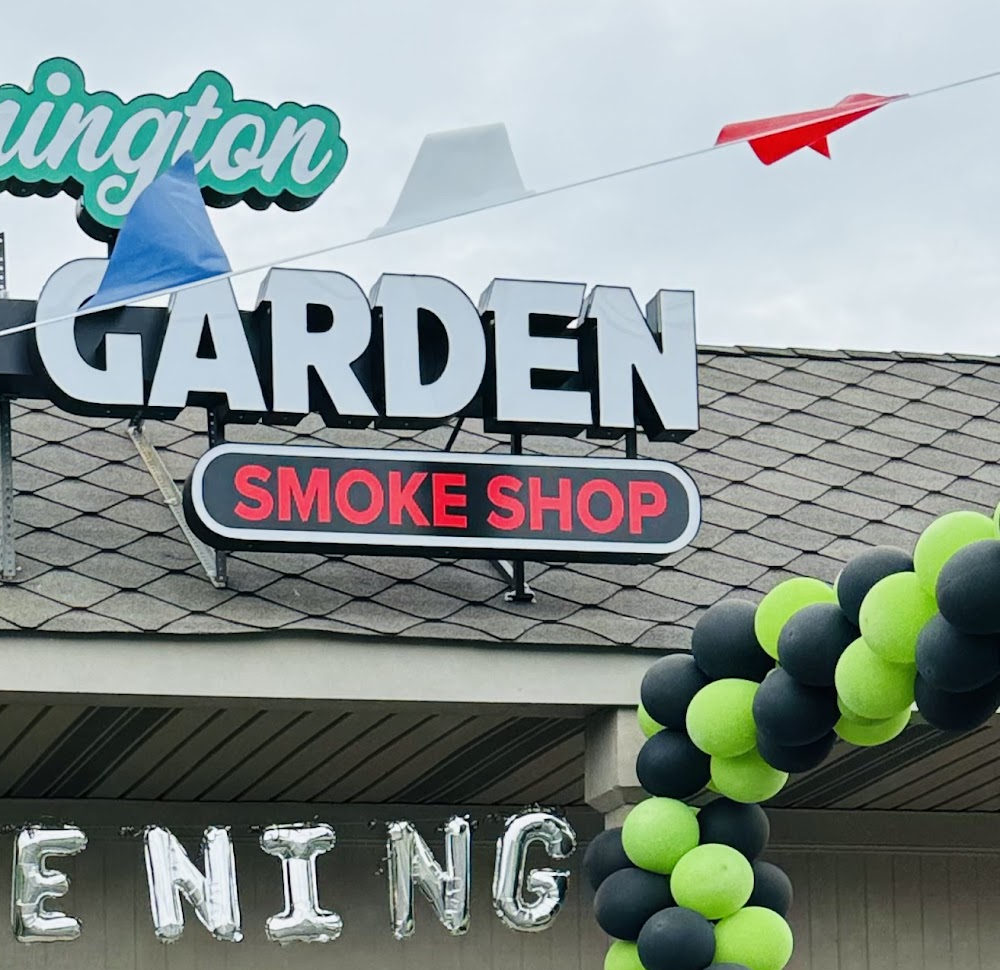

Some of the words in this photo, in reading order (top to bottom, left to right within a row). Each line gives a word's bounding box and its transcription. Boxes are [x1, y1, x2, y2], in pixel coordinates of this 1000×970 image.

[35, 258, 698, 434] GARDEN
[234, 464, 468, 529] SMOKE
[486, 474, 668, 535] SHOP
